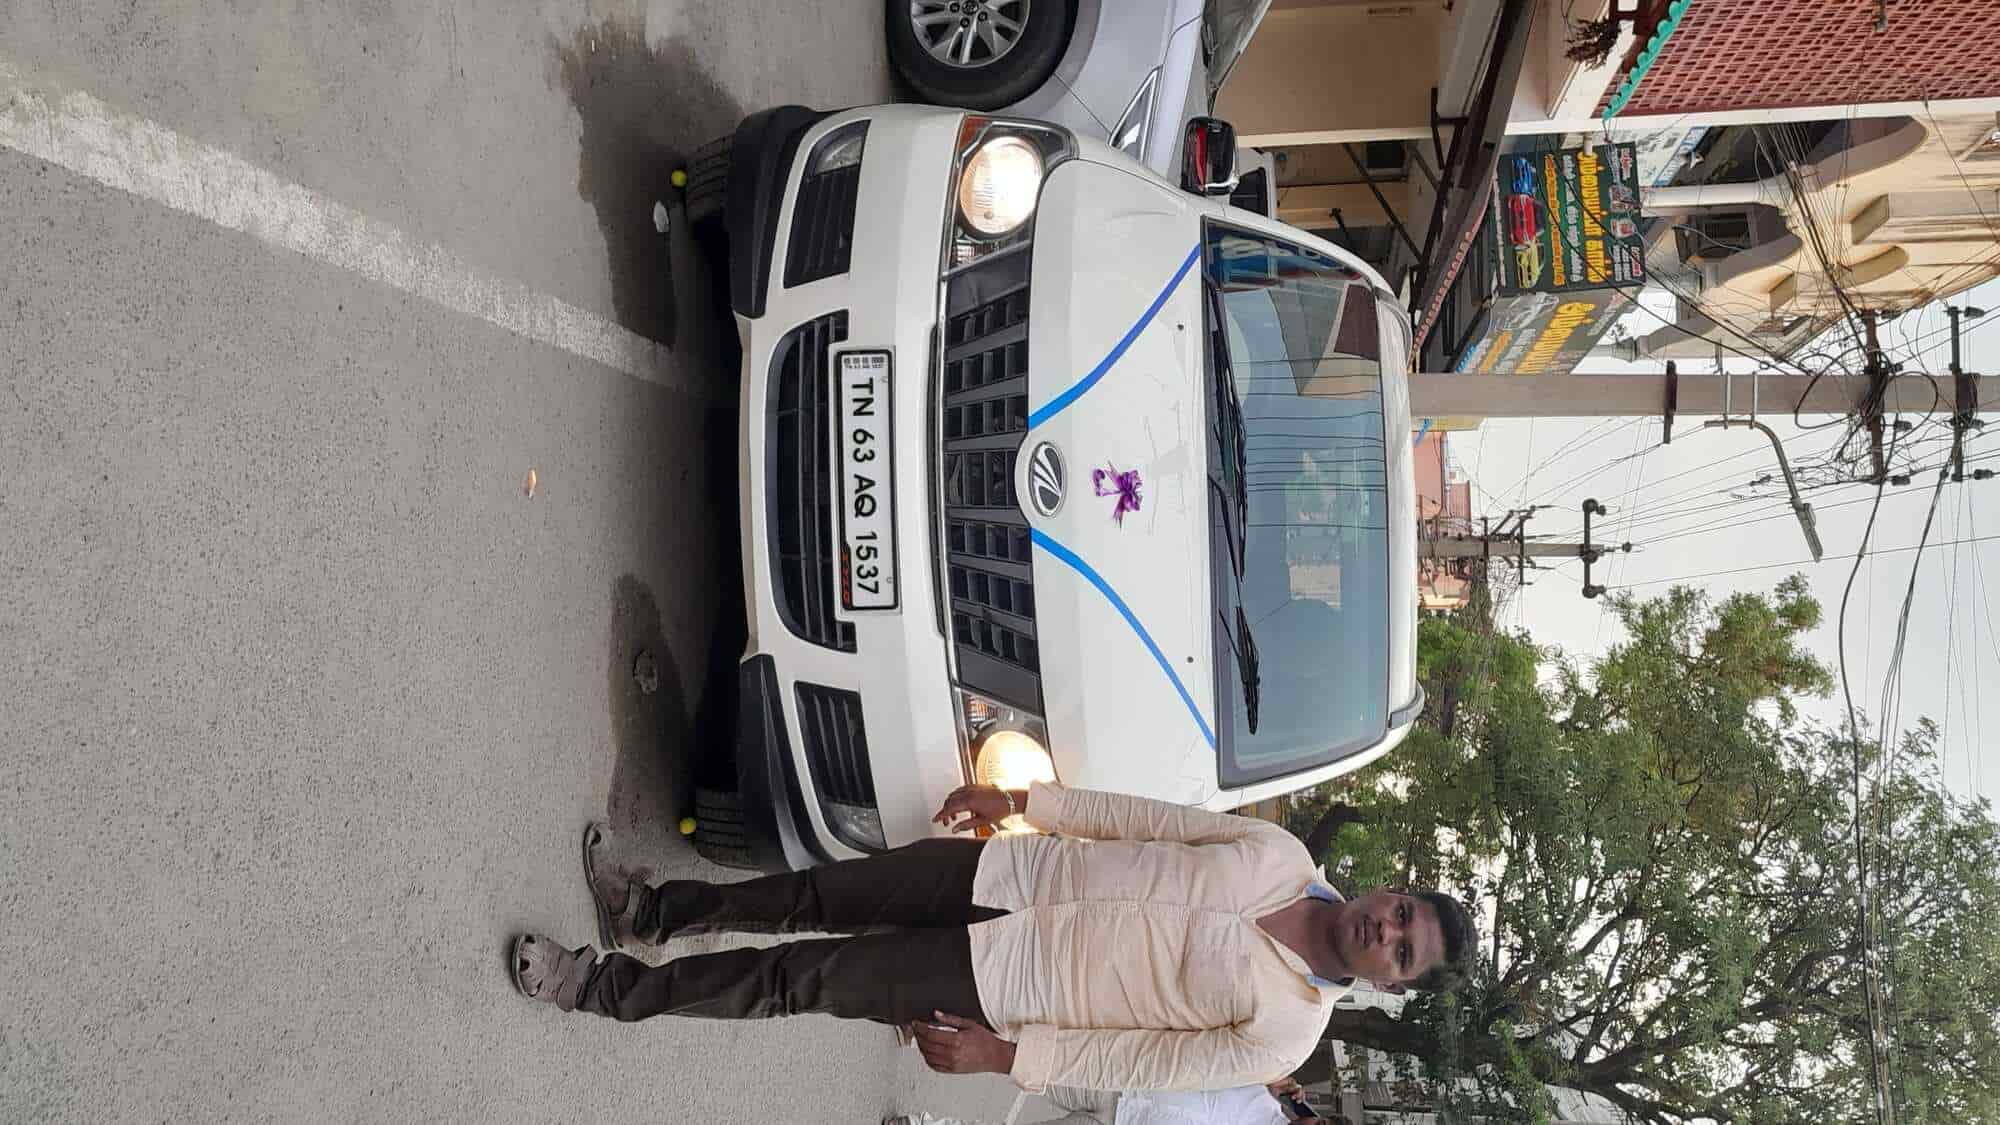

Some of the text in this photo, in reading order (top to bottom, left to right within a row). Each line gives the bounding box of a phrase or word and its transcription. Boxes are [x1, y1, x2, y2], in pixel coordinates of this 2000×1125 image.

[851, 377, 875, 416] TN
[852, 428, 875, 463] 63
[854, 473, 877, 518] AQ
[855, 531, 880, 594] 1537
